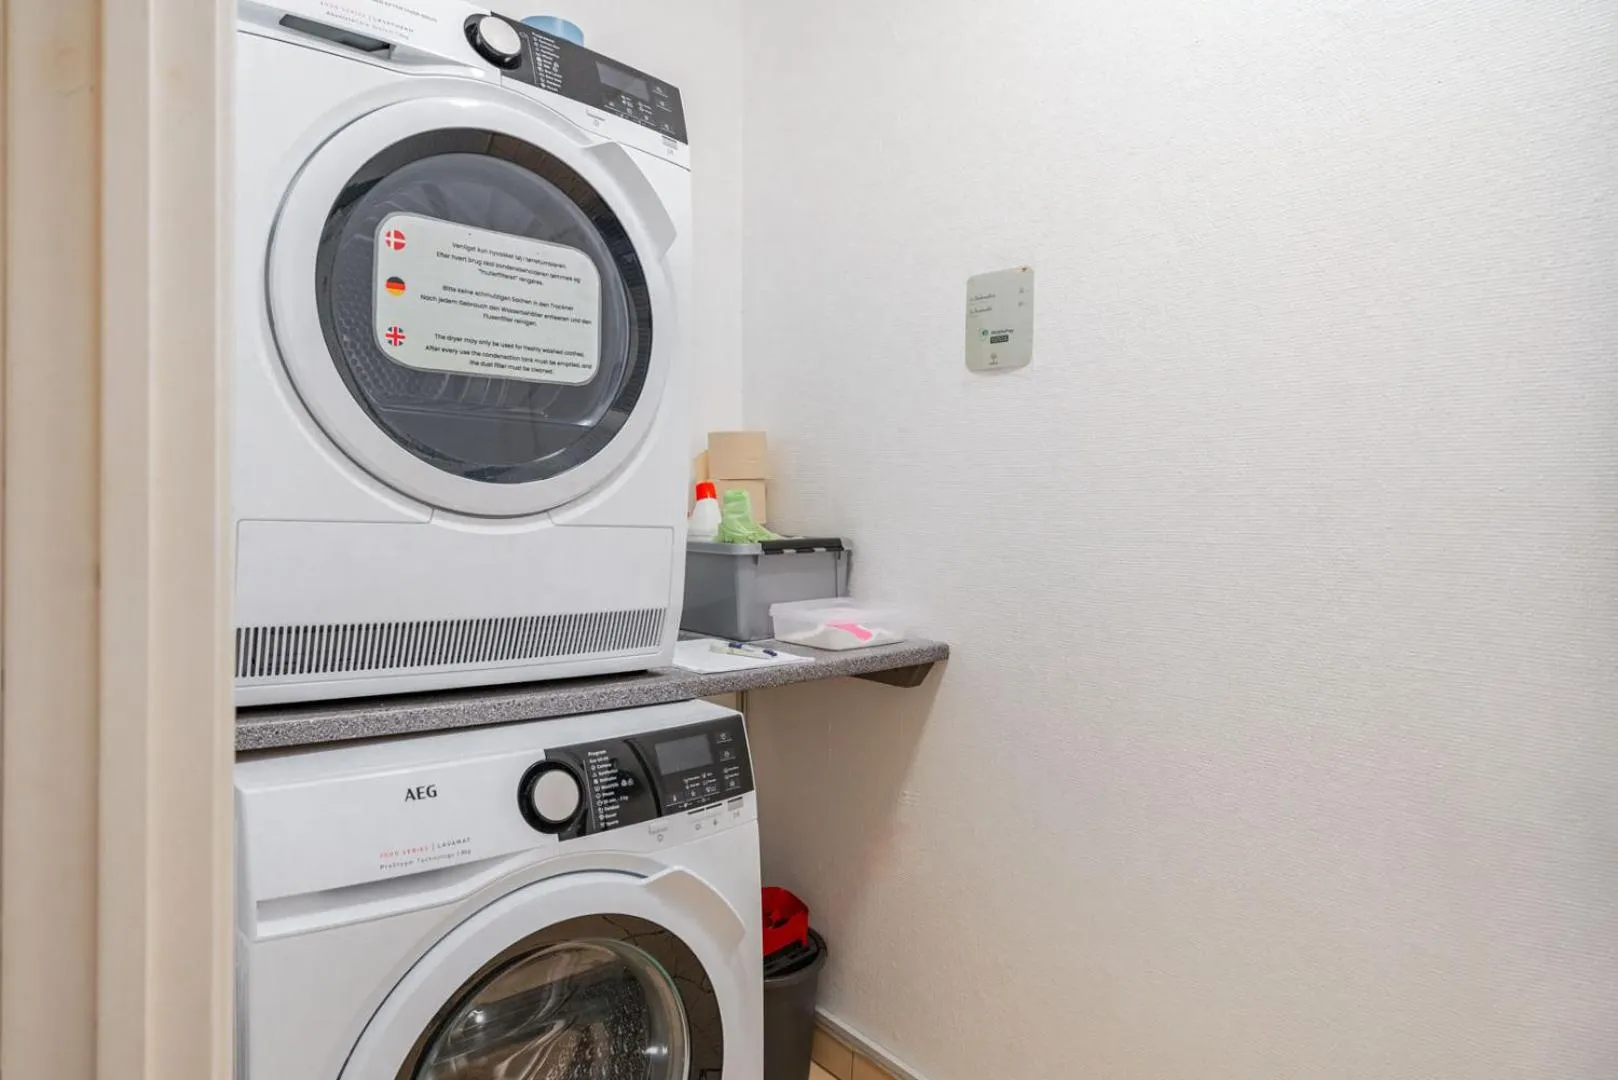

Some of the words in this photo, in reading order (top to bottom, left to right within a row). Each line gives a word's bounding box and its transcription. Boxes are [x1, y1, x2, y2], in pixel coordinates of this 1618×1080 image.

[420, 294, 437, 302] Nach
[458, 300, 488, 309] Gebrauch
[511, 296, 532, 305] Sachen
[446, 335, 463, 343] dryer
[523, 344, 541, 352] freshly
[441, 347, 458, 355] every
[482, 352, 520, 362] condensation
[405, 784, 437, 802] AEG
[438, 837, 470, 848] LAVAMAT
